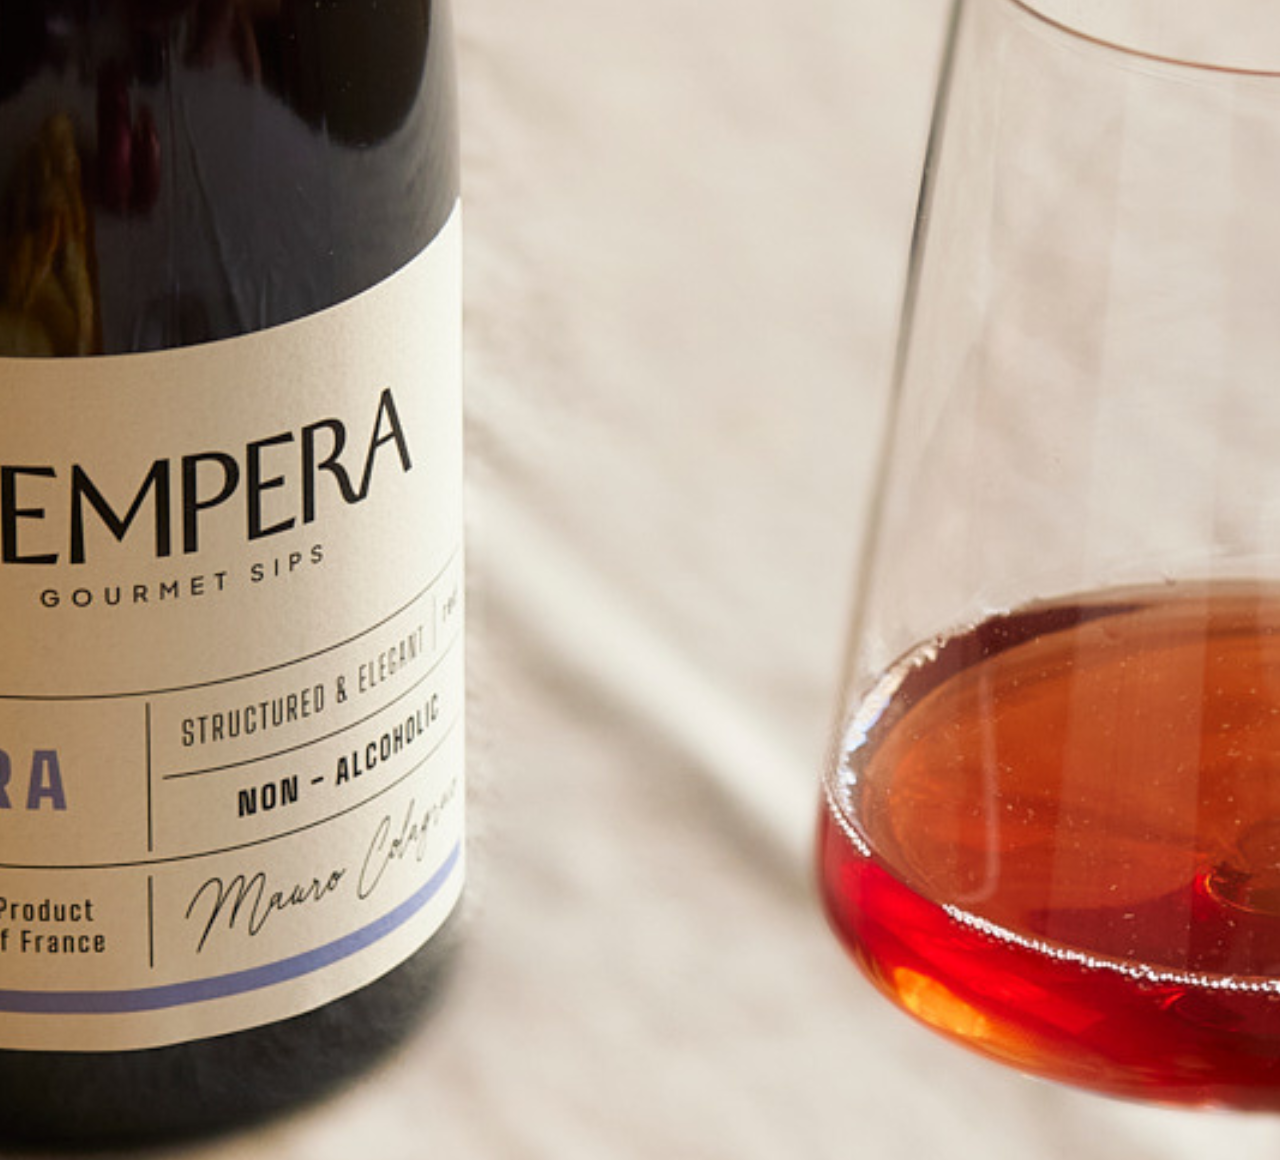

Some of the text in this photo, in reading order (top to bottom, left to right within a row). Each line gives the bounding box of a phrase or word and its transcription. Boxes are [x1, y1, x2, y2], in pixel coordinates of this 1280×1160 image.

[39, 544, 327, 609] GOURMET SIPS
[181, 625, 425, 748] STRUCTURED & ELEGANT
[237, 774, 300, 819] NON
[335, 693, 440, 787] ALCOHOLIC
[21, 930, 106, 955] France
[185, 867, 347, 955] Mauro
